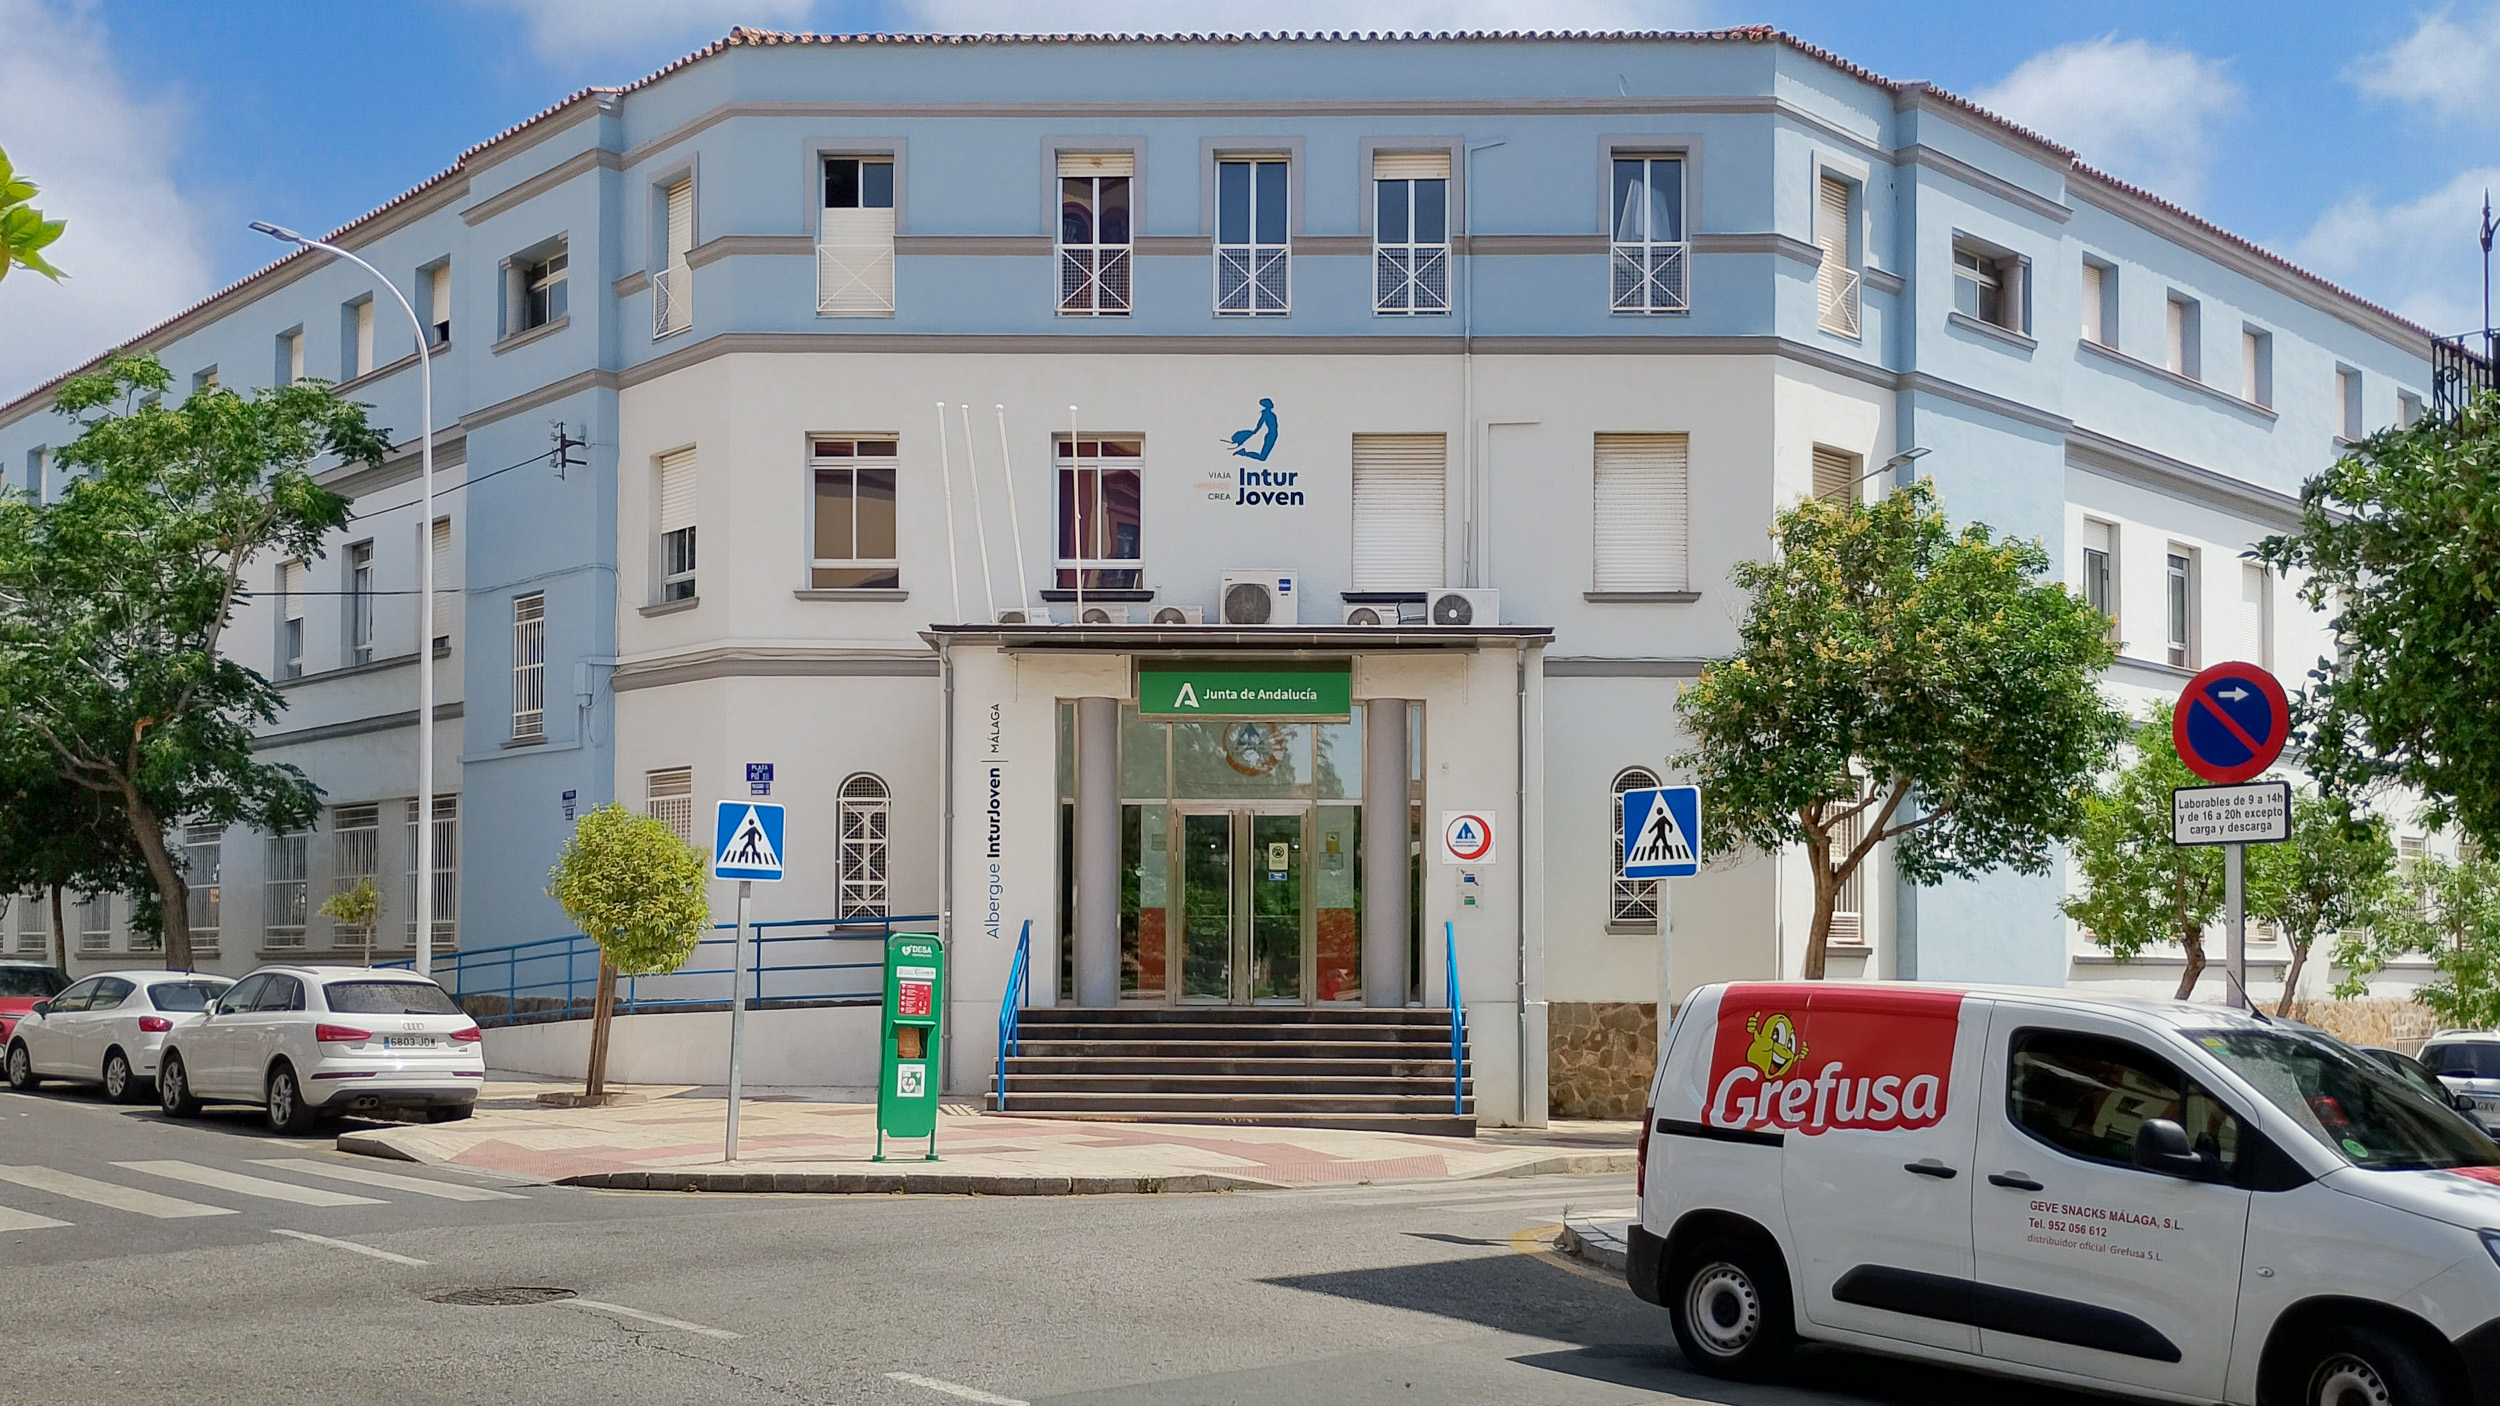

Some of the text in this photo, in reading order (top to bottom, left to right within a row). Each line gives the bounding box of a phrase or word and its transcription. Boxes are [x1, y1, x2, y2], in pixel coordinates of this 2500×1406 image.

[1240, 467, 1298, 486] Intur
[1236, 487, 1304, 505] Joven
[1203, 687, 1318, 701] Junta de Andalucía
[2178, 793, 2283, 809] Laborables de 9 a 14h
[984, 703, 1003, 939] Albergue InturJoven MÁLAGA
[2179, 807, 2283, 824] y de 16 a 20h excepto
[2189, 822, 2272, 836] carga y descarga
[912, 945, 932, 954] DESA
[390, 1037, 416, 1047] 6803
[1709, 1061, 1940, 1128] Grefusa
[2029, 1200, 2184, 1231] GEVE SNACKS MÁLAGA, S.L.
[2029, 1217, 2107, 1237] Tel. 952 056 612
[2027, 1233, 2163, 1262] distribuidor oficial Grefusa S.L.
